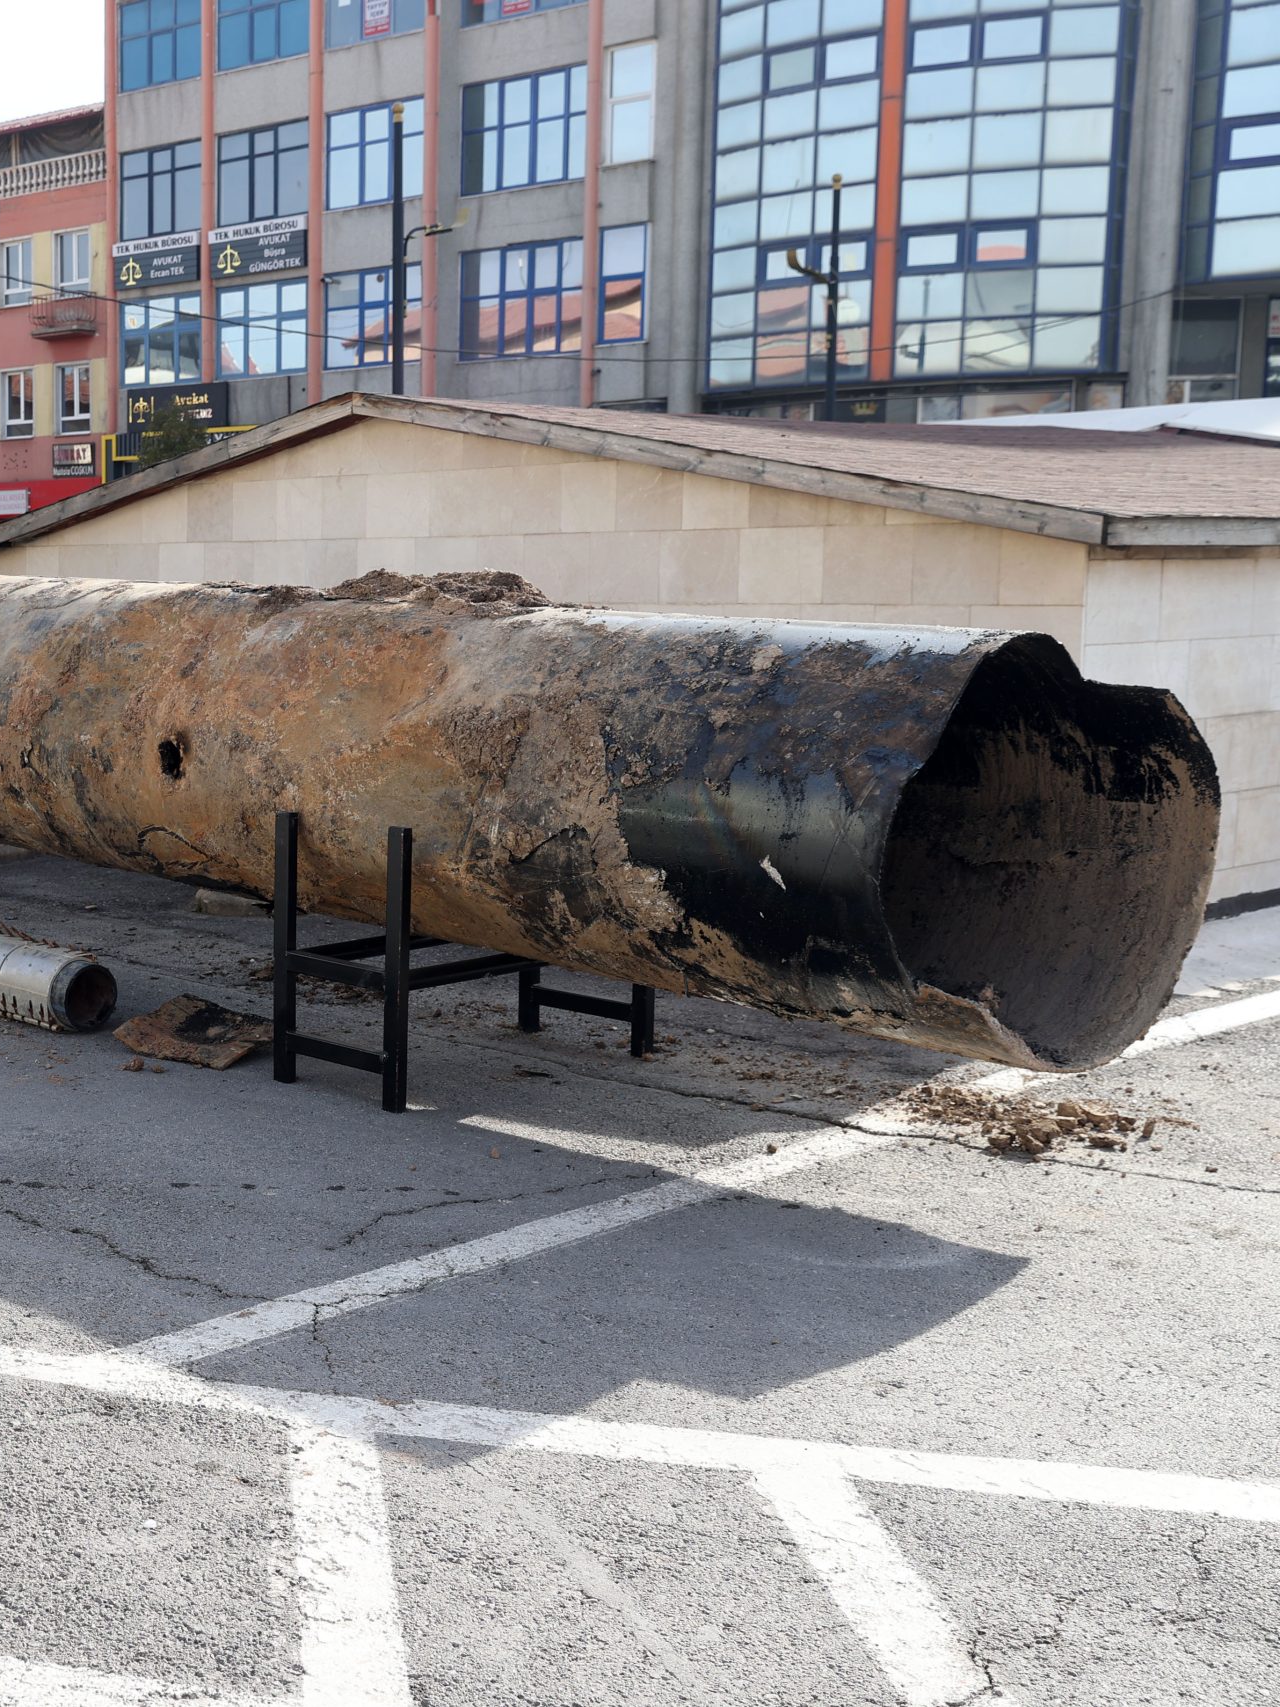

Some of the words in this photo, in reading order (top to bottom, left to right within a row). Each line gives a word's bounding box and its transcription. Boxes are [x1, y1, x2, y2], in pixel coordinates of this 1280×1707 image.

[214, 231, 229, 241] TEK
[232, 225, 261, 238] HUKUK
[263, 219, 298, 233] BÜROSU
[116, 245, 130, 254] TEK
[133, 241, 159, 252] HUKUK
[161, 235, 193, 248] BÜROSU
[258, 233, 291, 246] AVUKAT
[152, 254, 183, 266] AVUKAT
[248, 259, 285, 273] GÜNGÖR
[285, 256, 301, 267] TEK
[150, 269, 170, 279] Ercan
[170, 266, 184, 276] TEK
